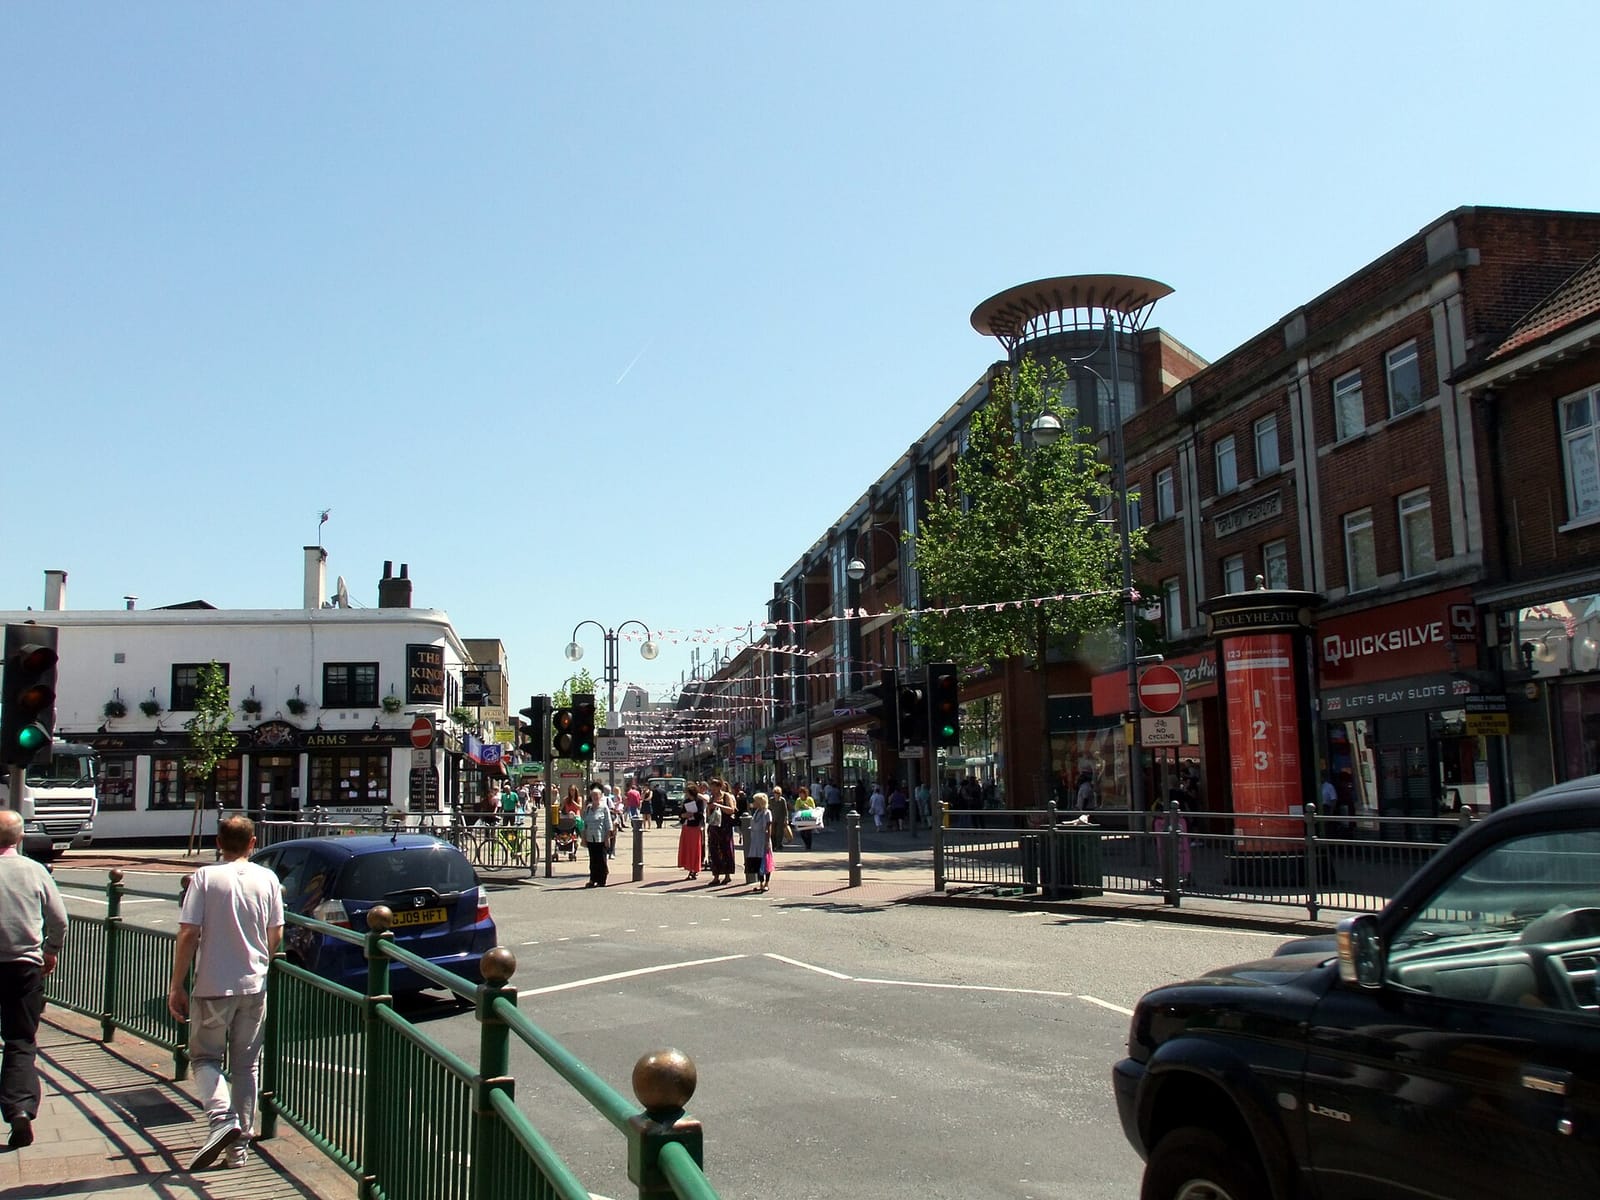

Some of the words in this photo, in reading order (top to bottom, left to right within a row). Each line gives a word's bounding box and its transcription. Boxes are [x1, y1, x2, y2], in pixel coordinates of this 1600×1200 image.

[1452, 605, 1476, 633] Q
[1322, 621, 1444, 667] QUICKSILVE
[417, 651, 440, 665] THE
[1346, 694, 1374, 708] LET'S
[1378, 691, 1404, 703] PLAY
[1408, 685, 1446, 699] SLOTS
[307, 735, 347, 745] ARMS
[1253, 721, 1267, 740] 2
[1254, 751, 1268, 770] 3
[422, 909, 443, 921] HFT
[1307, 1103, 1351, 1121] L200
